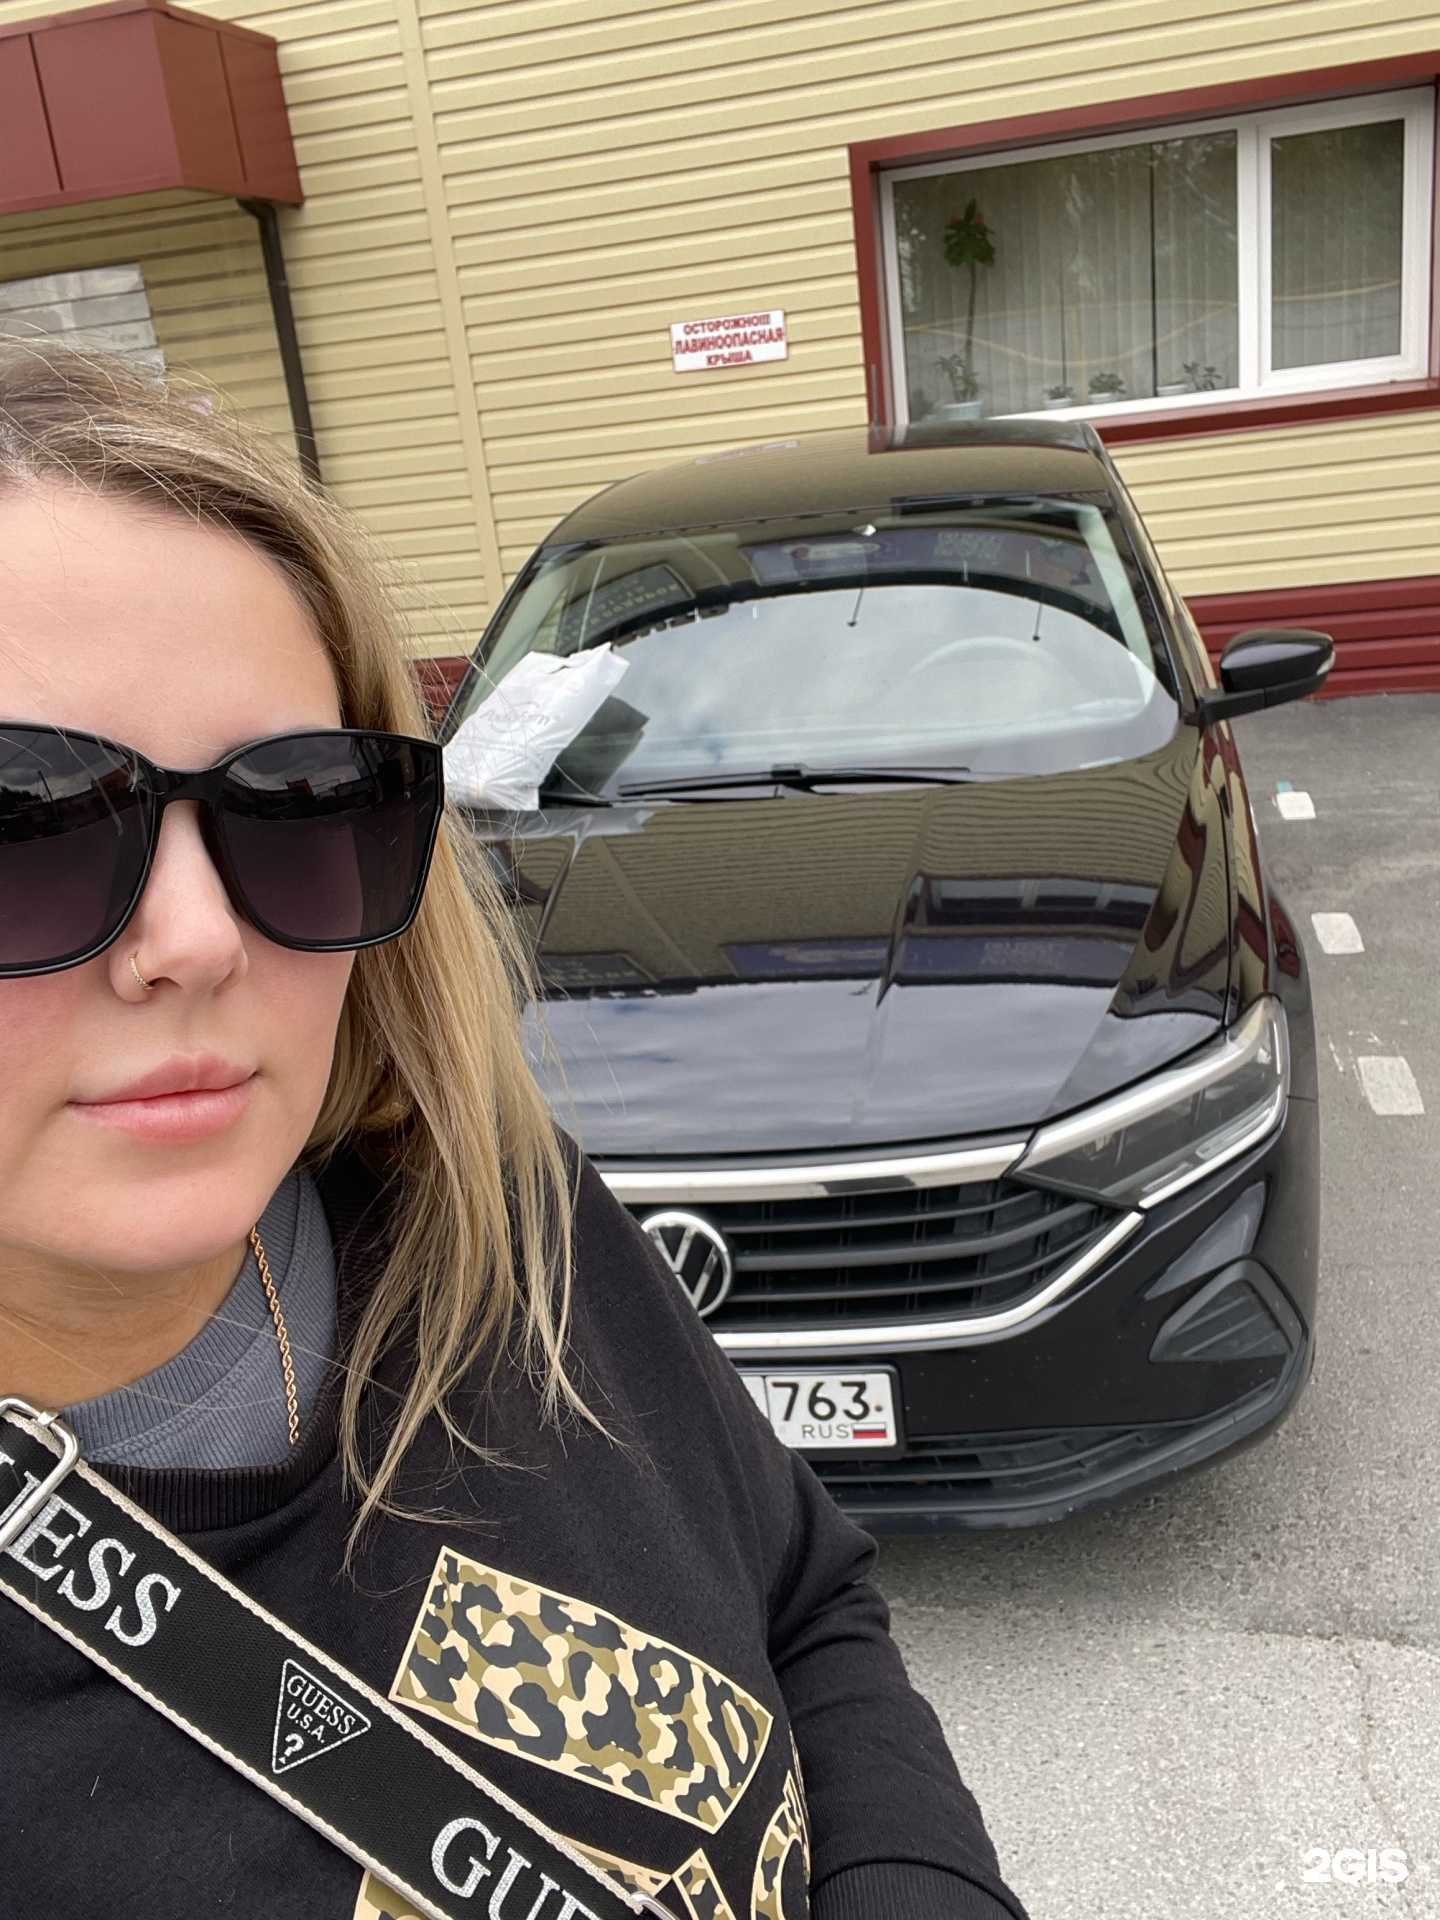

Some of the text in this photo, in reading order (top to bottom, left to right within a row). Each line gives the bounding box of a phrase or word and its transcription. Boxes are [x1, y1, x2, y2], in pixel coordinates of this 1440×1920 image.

[675, 327, 784, 354] ЛАВИНООПАСНАЯ
[706, 350, 753, 366] КРЫША
[771, 1381, 870, 1421] 763
[802, 1424, 849, 1439] RUS
[286, 1675, 356, 1735] GUESS
[286, 1703, 325, 1744] U.S.A.
[279, 1733, 304, 1765] ?
[431, 1817, 605, 1920] GU
